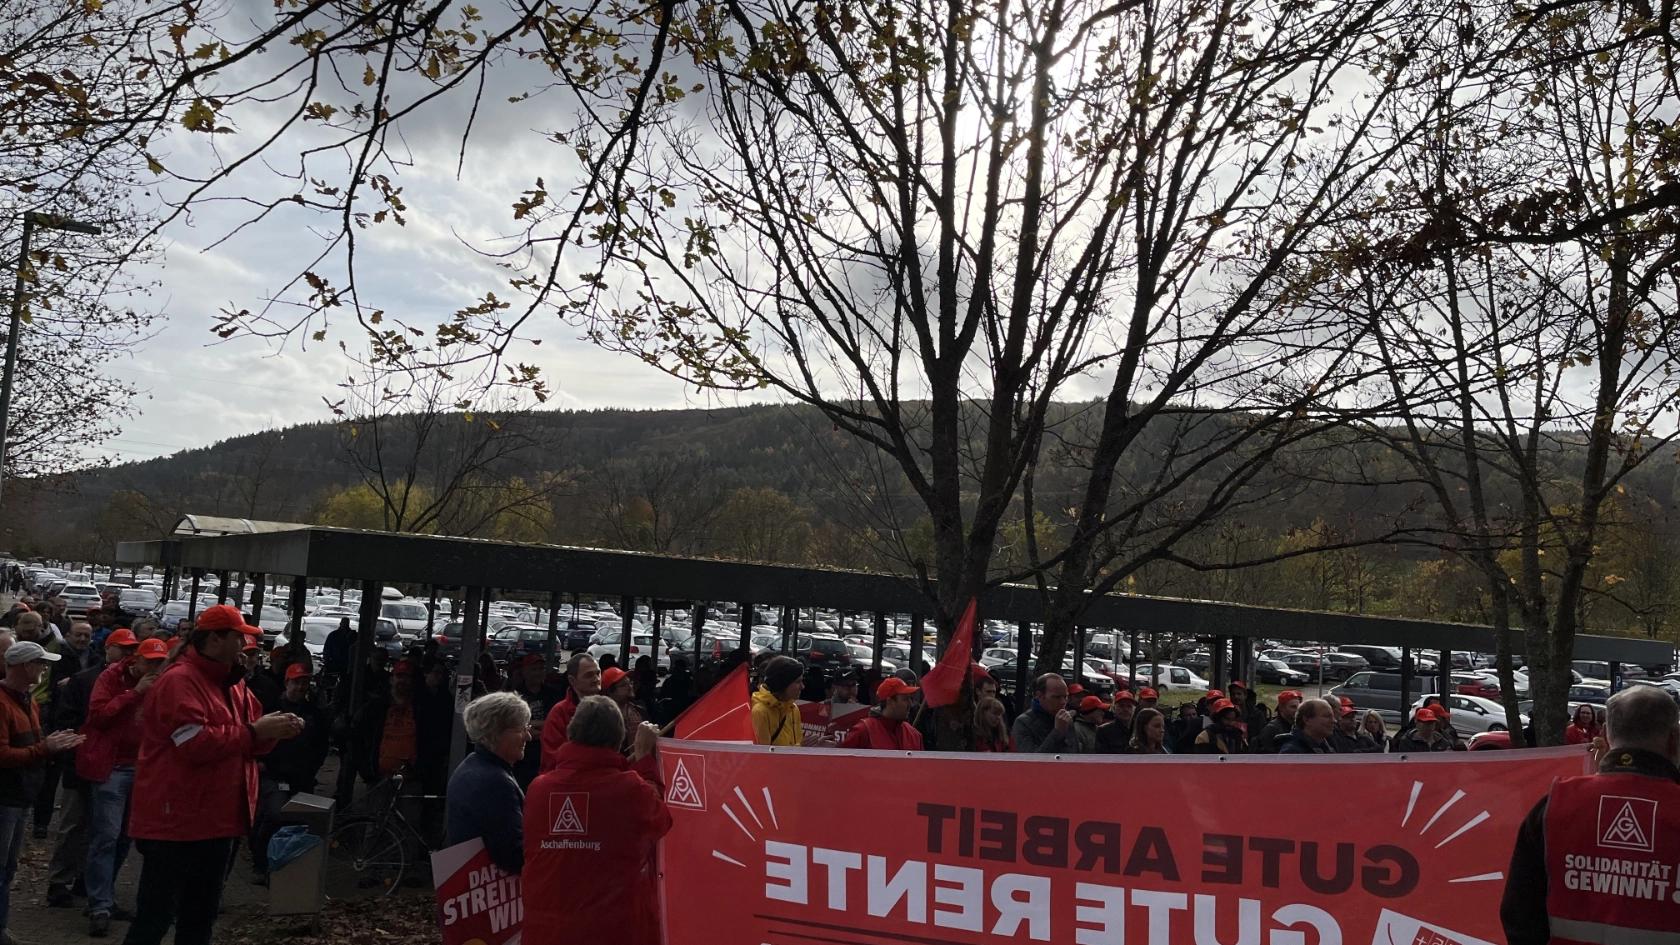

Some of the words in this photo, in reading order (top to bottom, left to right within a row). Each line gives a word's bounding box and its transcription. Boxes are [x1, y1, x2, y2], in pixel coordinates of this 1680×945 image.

[1616, 675, 1622, 687] P
[1605, 805, 1645, 844] IGM
[540, 838, 602, 851] Aschaffenburg
[1565, 854, 1671, 880] SOLIDARITÄT
[443, 875, 522, 926] STREIT
